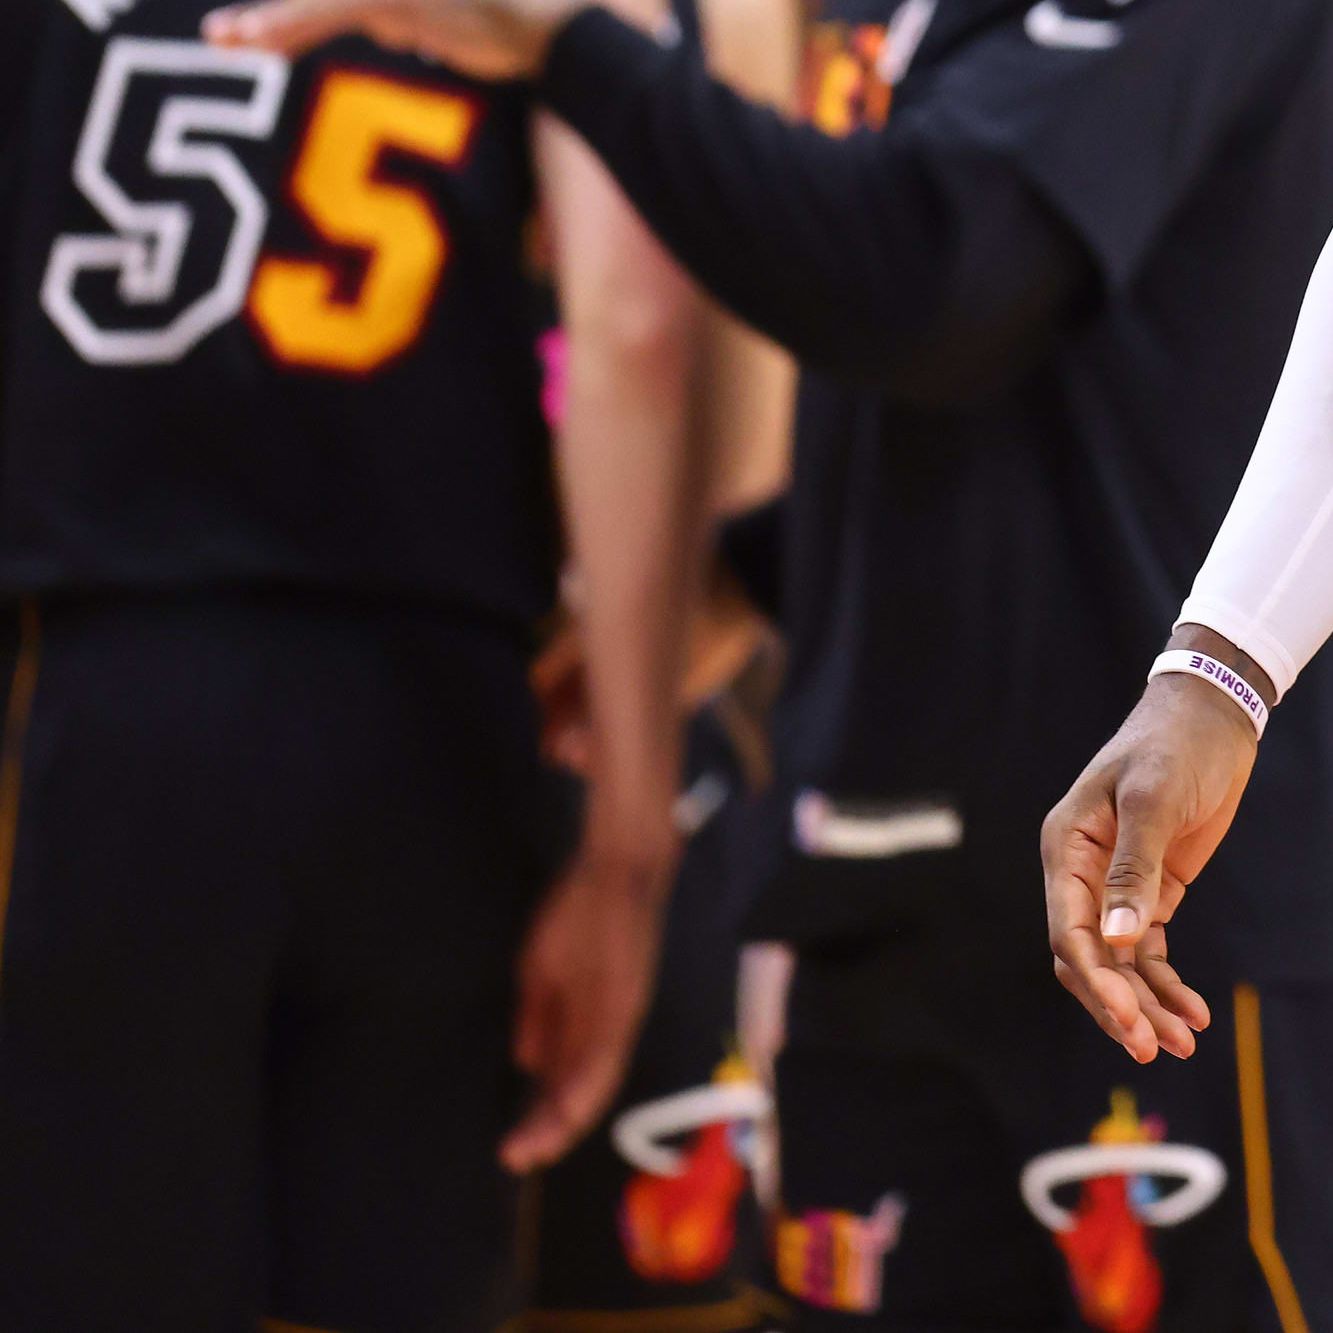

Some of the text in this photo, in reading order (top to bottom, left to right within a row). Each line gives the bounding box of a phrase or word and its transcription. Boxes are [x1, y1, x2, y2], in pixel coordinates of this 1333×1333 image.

[39, 35, 483, 377] 55
[1188, 655, 1264, 720] I PROMISE
